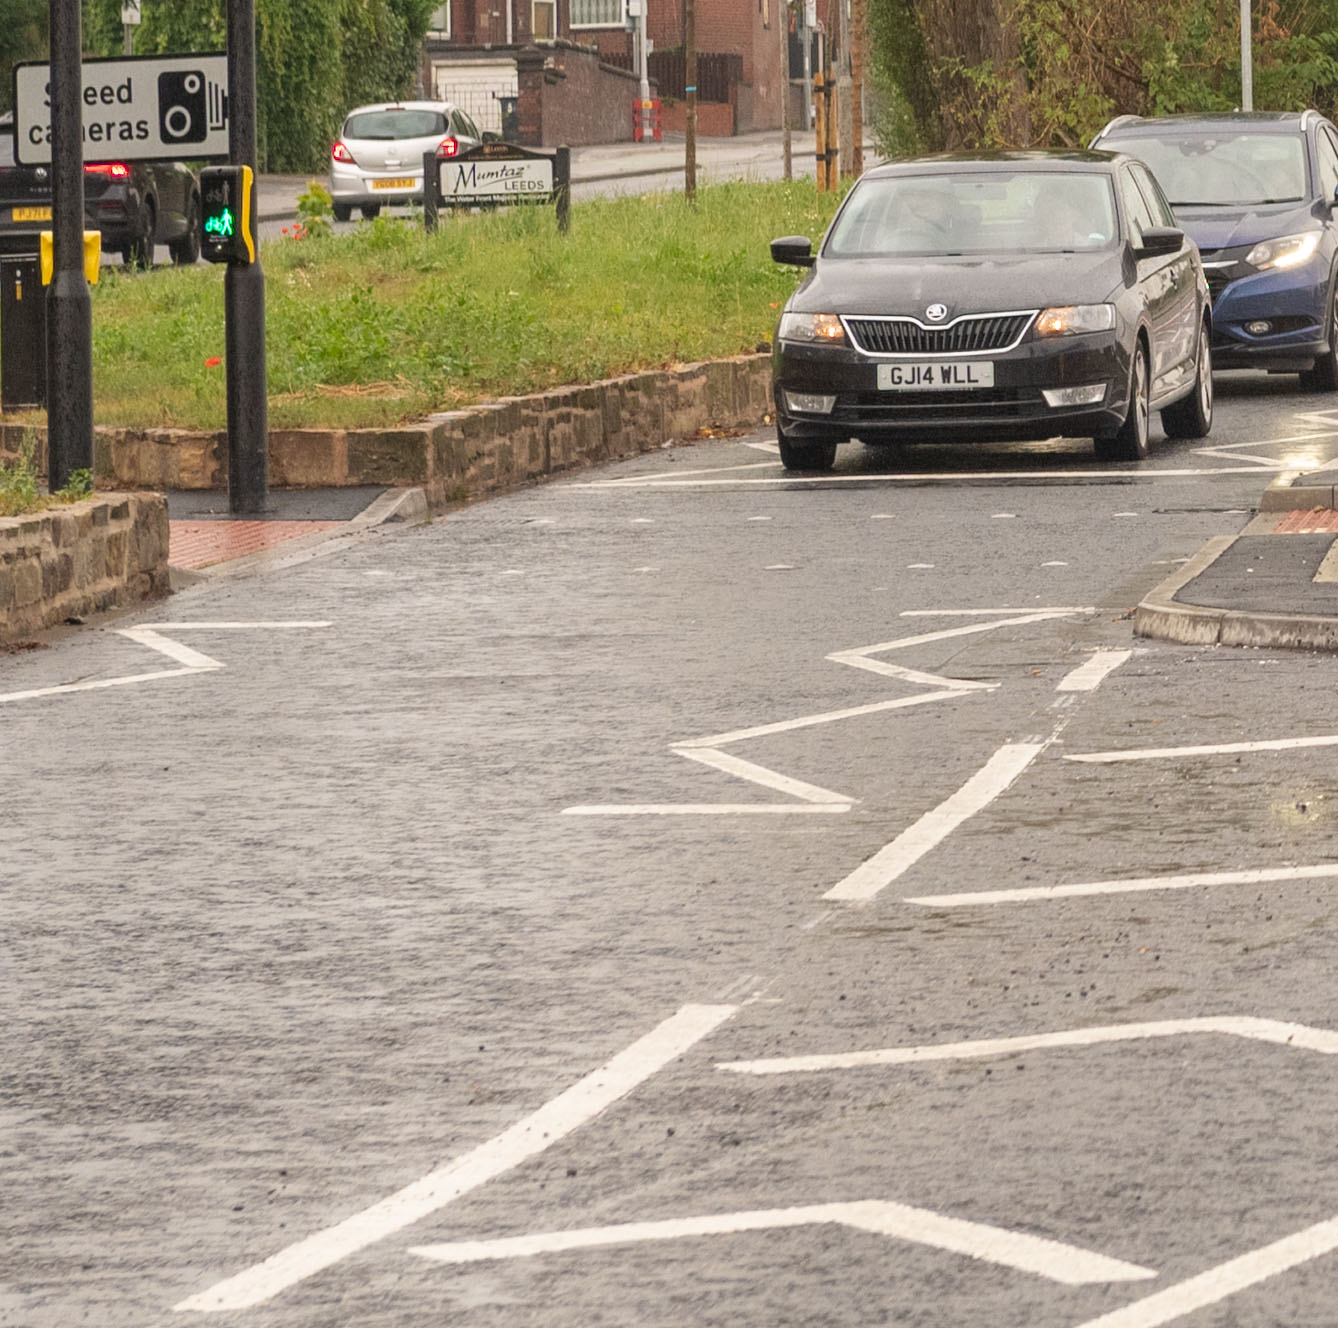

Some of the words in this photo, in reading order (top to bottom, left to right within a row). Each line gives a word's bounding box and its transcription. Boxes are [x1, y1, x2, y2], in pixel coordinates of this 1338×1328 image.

[453, 162, 525, 194] Mumtaz
[504, 180, 545, 191] LEEDS
[890, 366, 934, 385] GJ14
[941, 364, 979, 384] WLL
